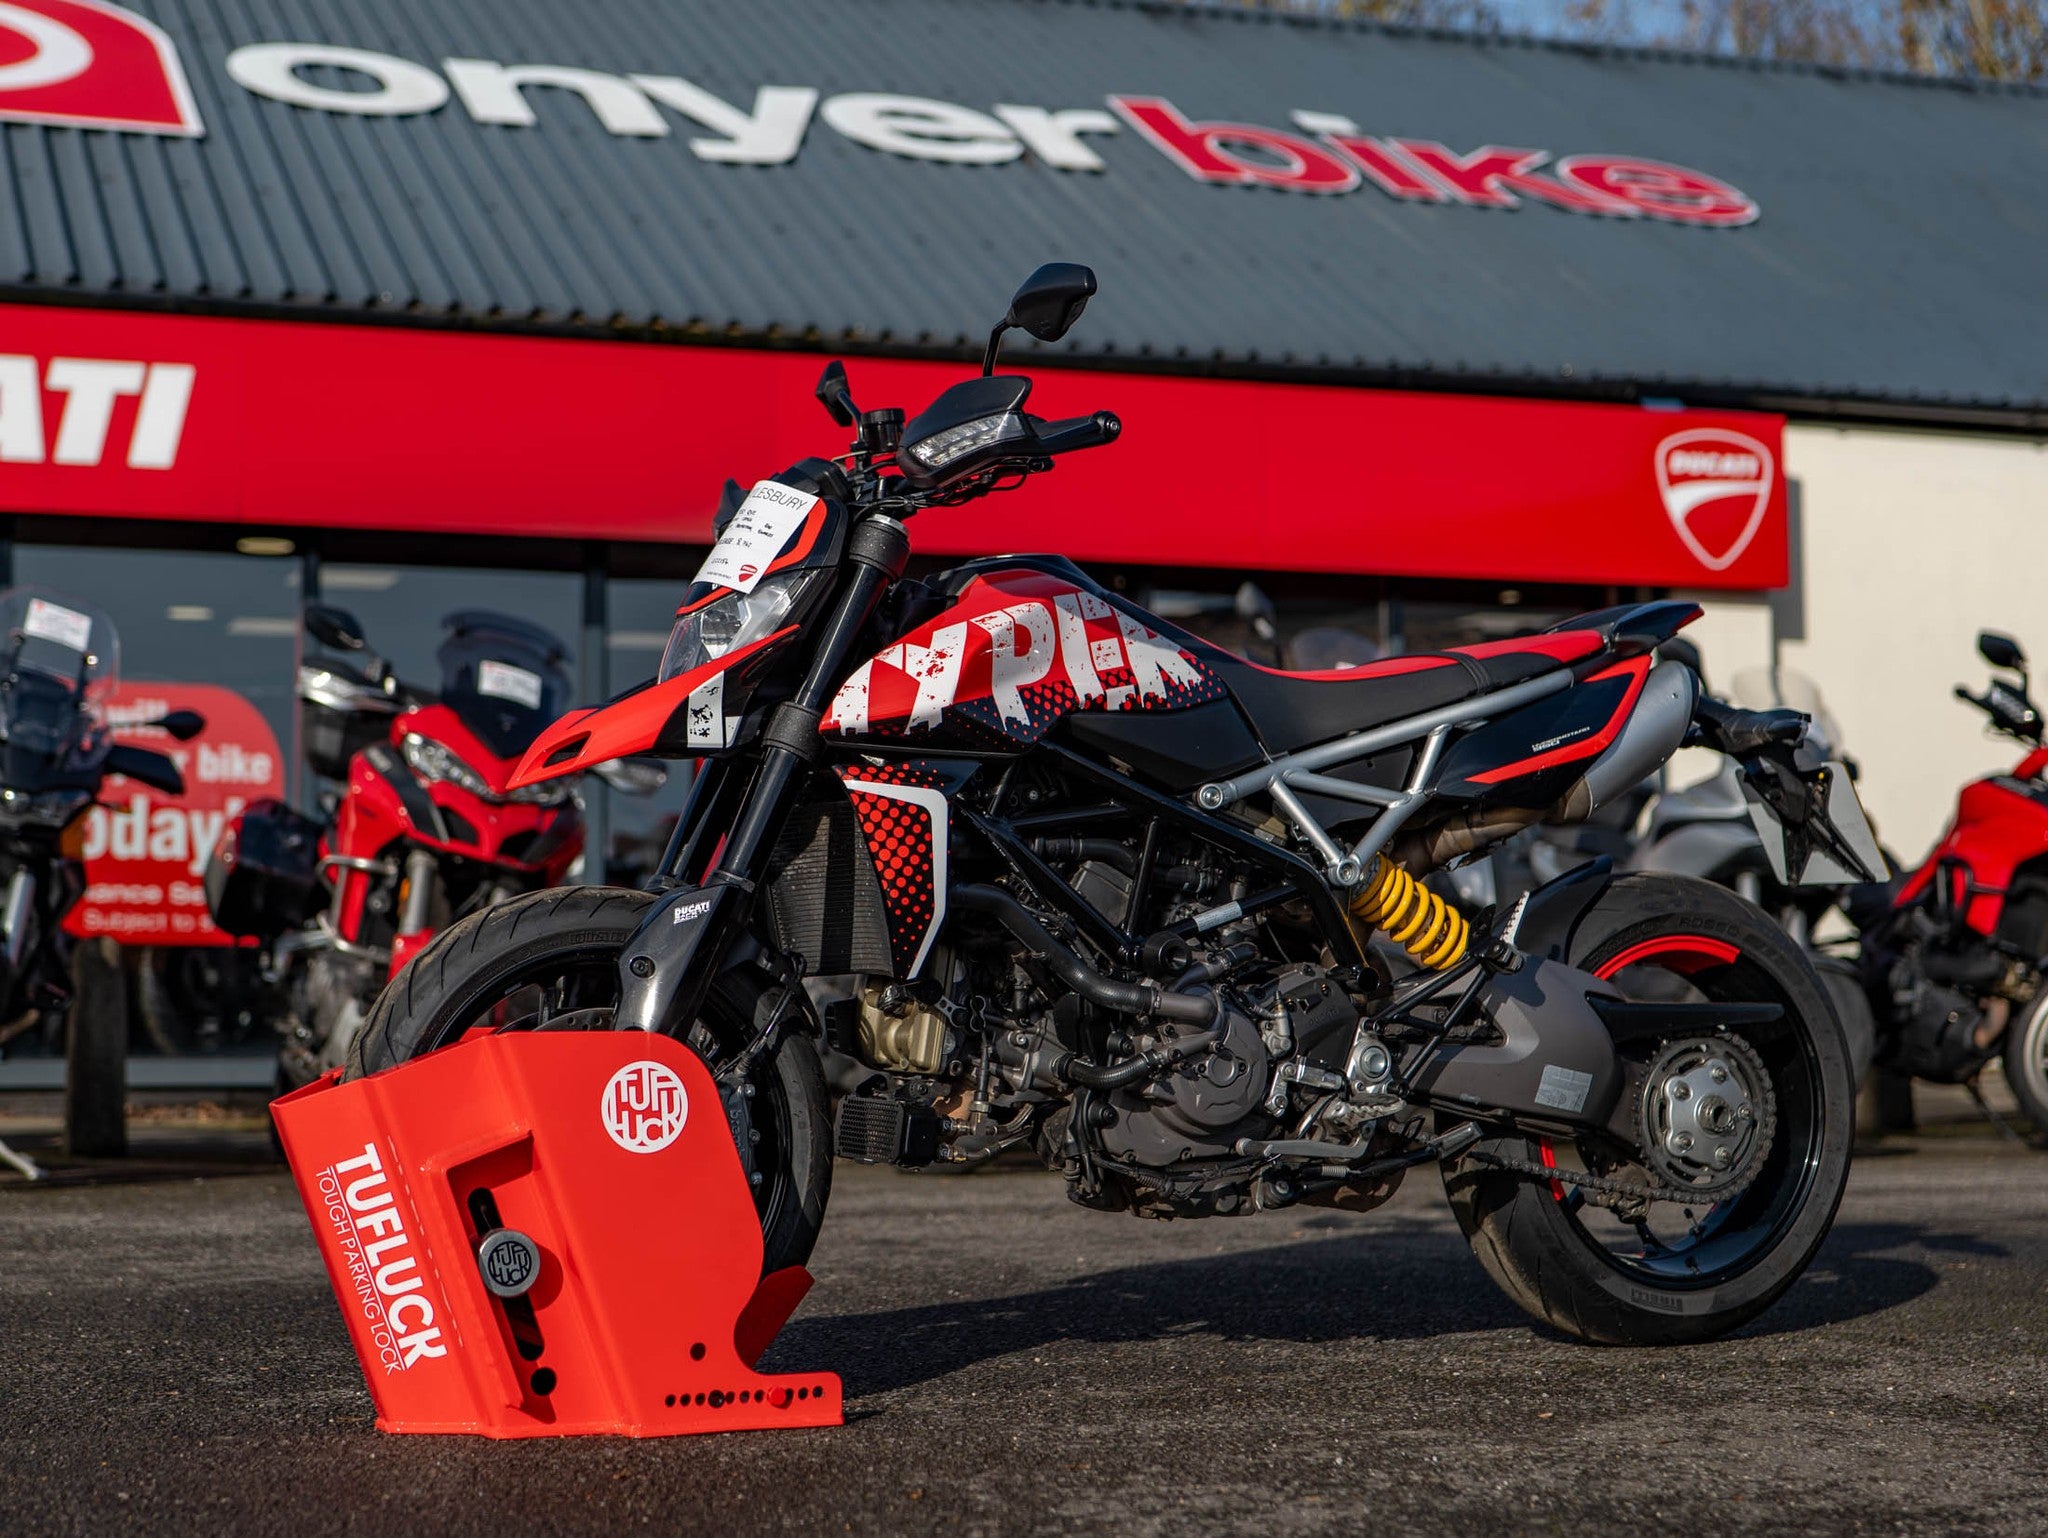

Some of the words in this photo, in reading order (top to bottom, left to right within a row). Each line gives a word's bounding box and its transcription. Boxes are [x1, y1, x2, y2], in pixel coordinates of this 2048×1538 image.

[1669, 449, 1760, 478] DUCATI
[196, 743, 272, 785] bike
[674, 901, 710, 916] DUCATI
[315, 1166, 351, 1236] TOUGH
[339, 1237, 381, 1320] PARKING
[369, 1321, 402, 1376] LOCK
[335, 1142, 448, 1370] TUFLUCK
